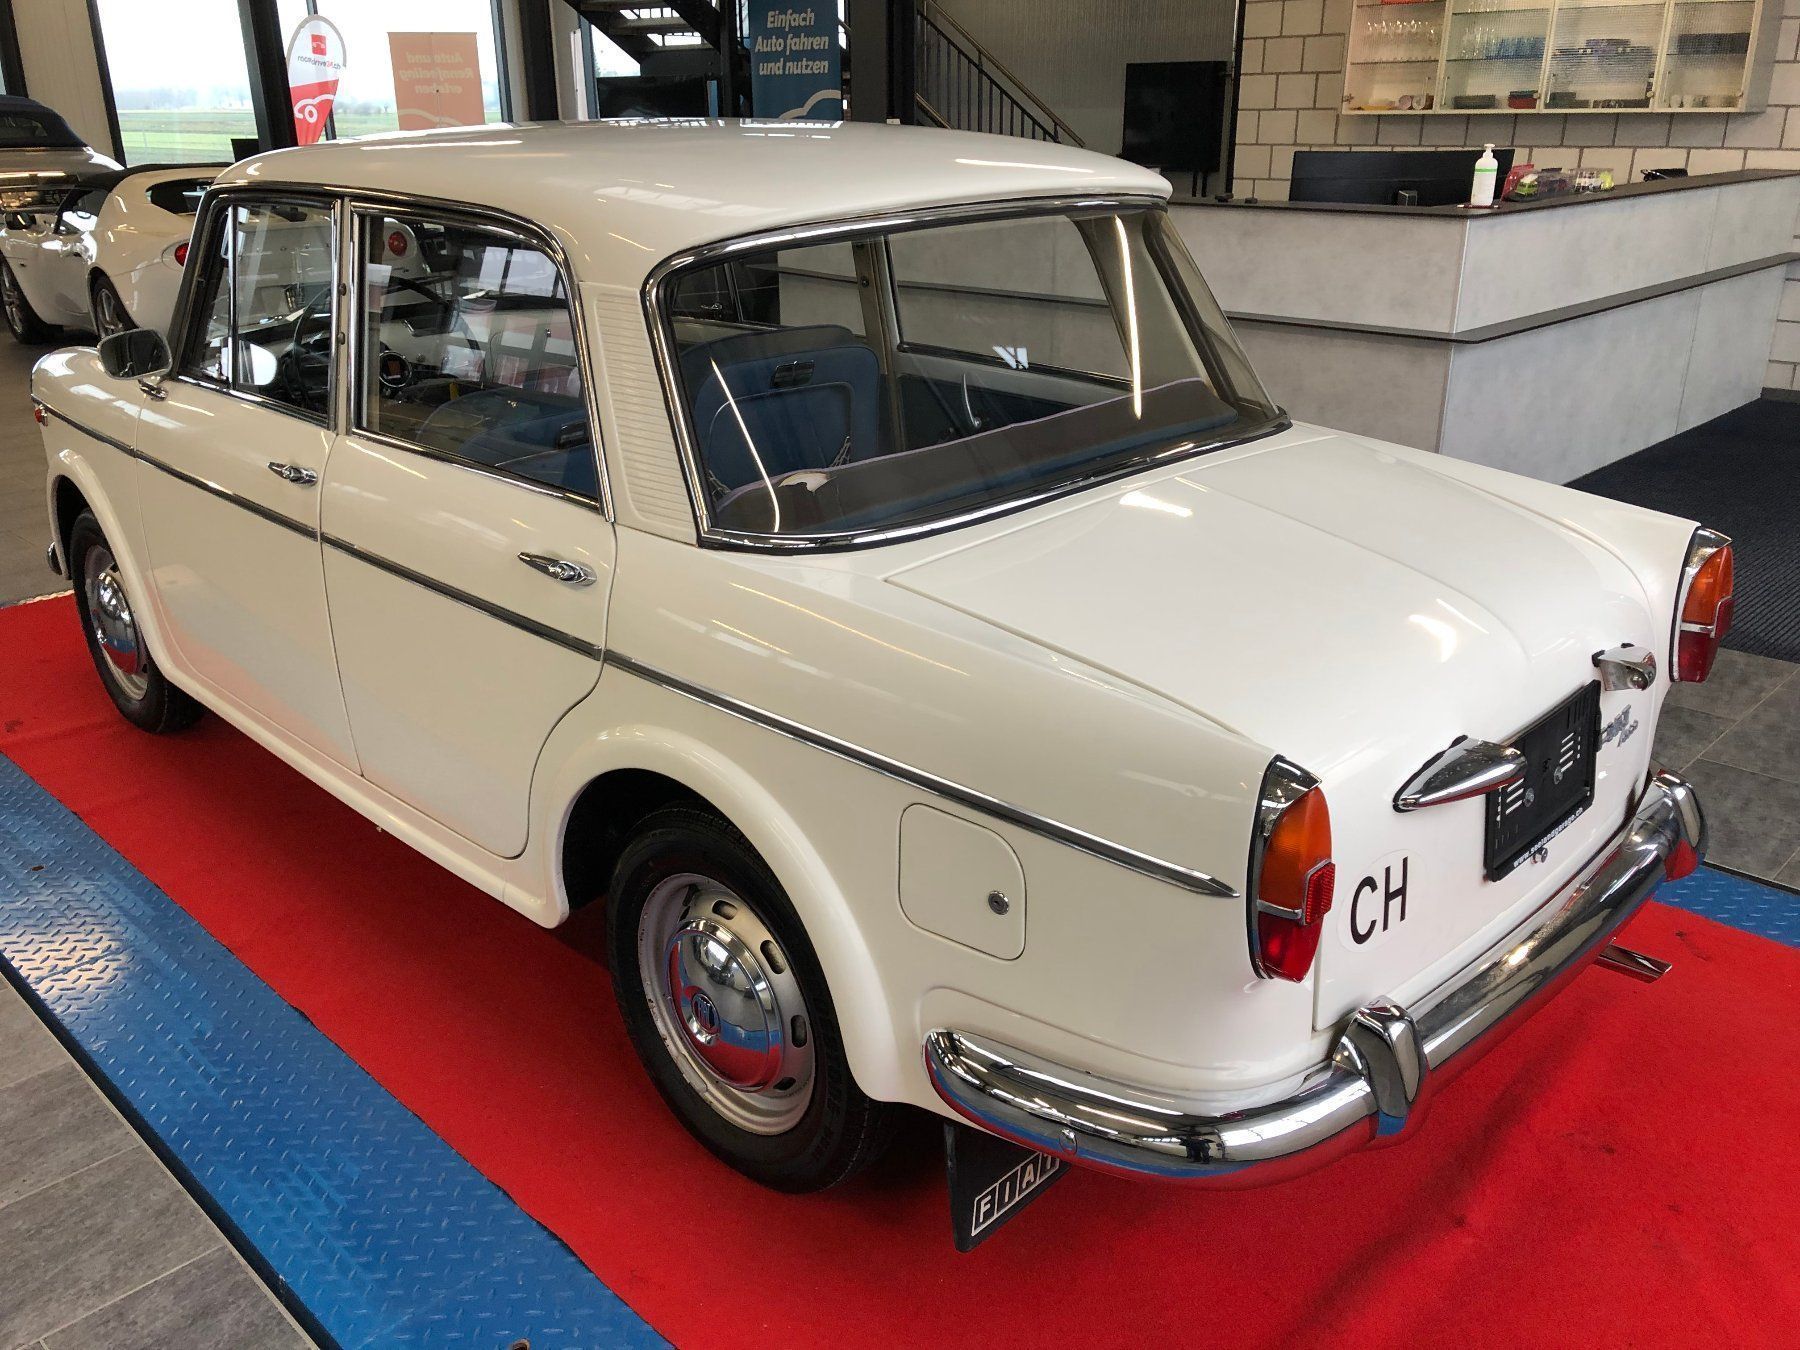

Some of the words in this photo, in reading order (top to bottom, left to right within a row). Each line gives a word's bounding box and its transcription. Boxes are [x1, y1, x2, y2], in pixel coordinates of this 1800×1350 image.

[767, 8, 815, 31] Einfach
[755, 35, 784, 52] Auto
[785, 33, 829, 55] fahren
[760, 58, 784, 75] und
[785, 58, 829, 75] nutzen
[1513, 807, 1584, 868] www.seelandgarage.ch
[1350, 855, 1408, 945] CH
